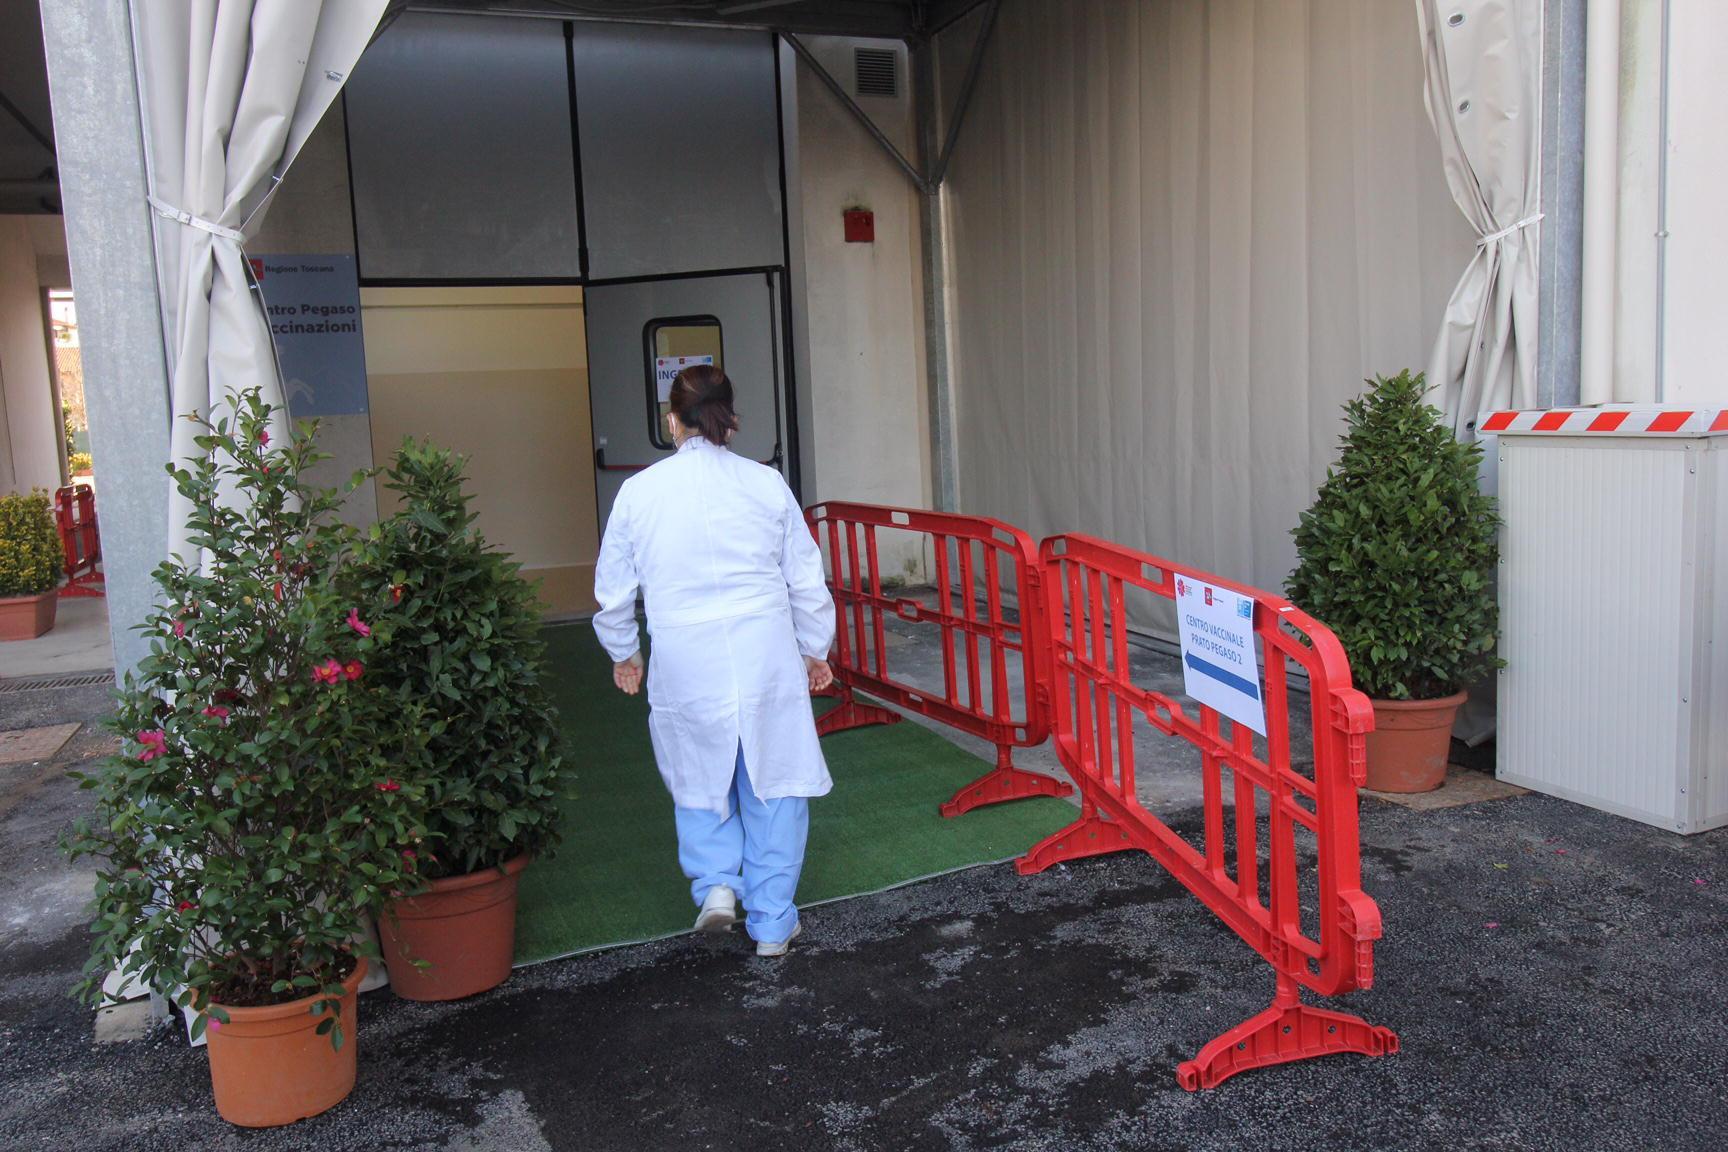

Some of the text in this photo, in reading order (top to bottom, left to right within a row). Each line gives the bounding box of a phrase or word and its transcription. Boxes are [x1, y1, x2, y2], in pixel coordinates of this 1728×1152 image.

[265, 265, 298, 273] Regione
[267, 303, 356, 316] ntro Pegaso
[272, 320, 357, 334] ccinazioni
[1186, 614, 1244, 648] CENTRO VACCINALE
[1191, 633, 1242, 665] PRATO PEGASO 2
